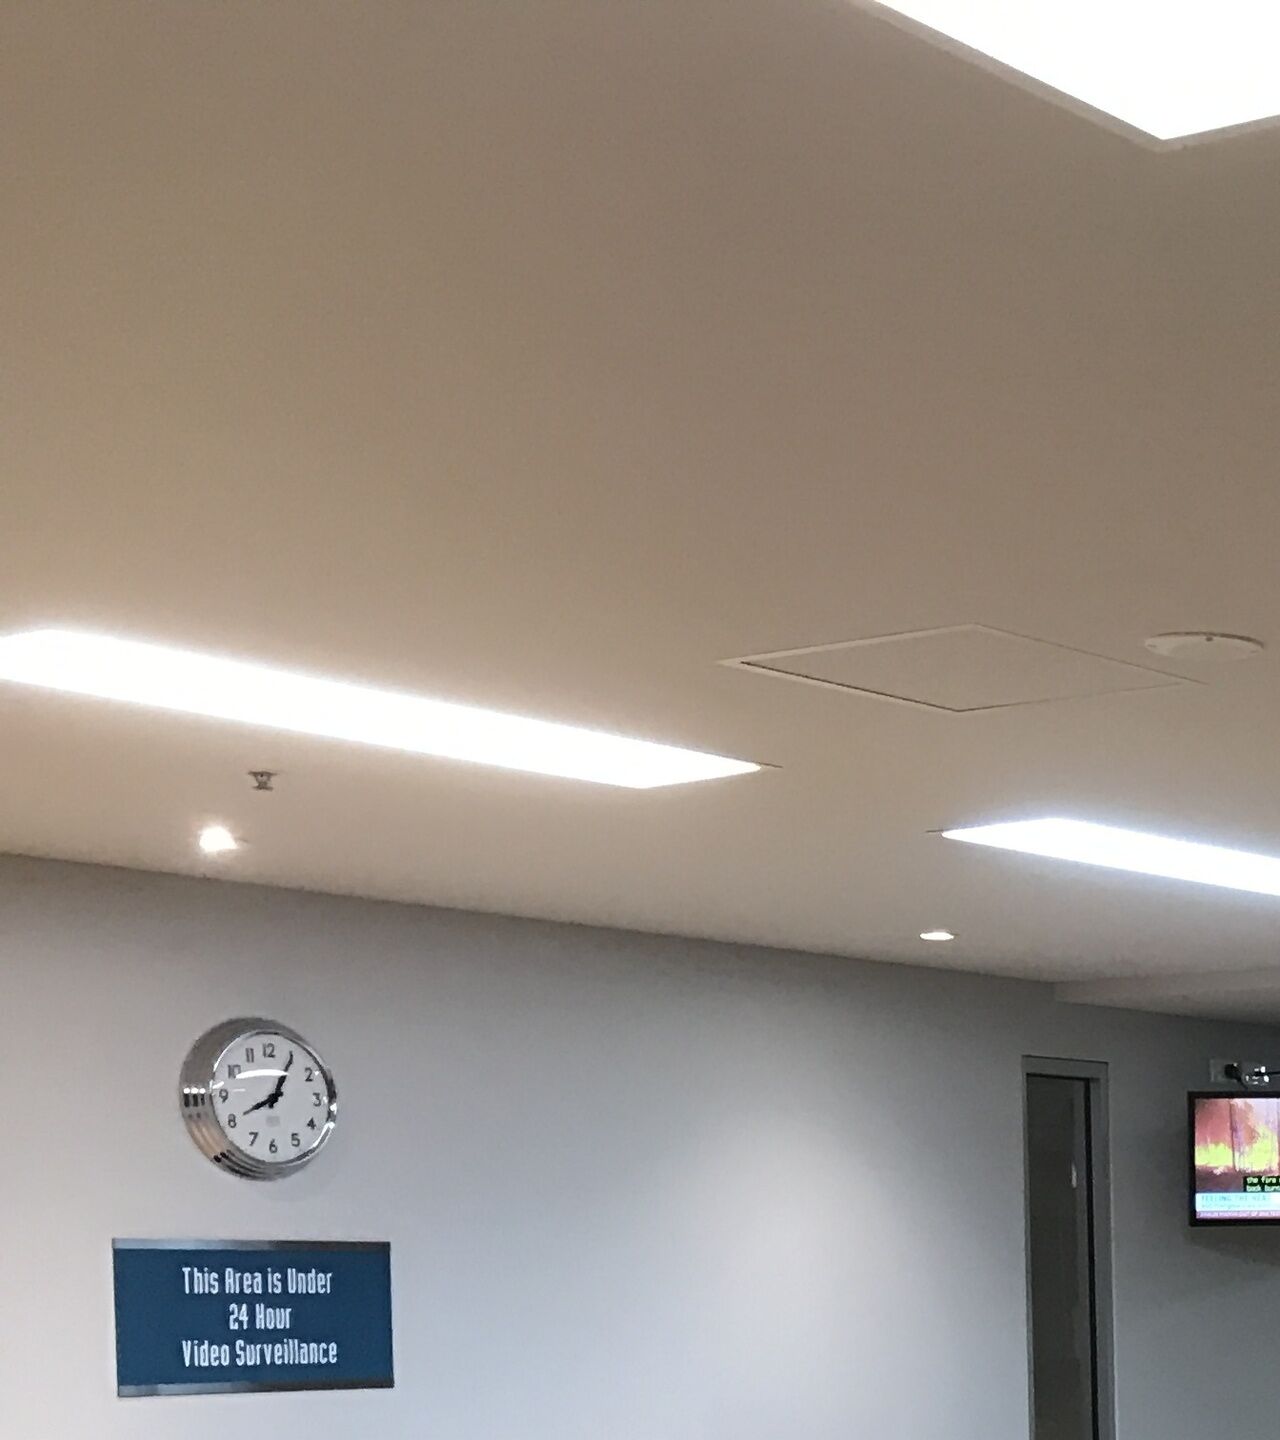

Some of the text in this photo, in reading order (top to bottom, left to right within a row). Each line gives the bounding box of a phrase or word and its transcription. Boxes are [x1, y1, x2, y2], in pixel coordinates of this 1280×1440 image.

[245, 1048, 254, 1063] 11
[262, 1043, 276, 1058] 12
[304, 1067, 314, 1082] 2
[219, 1089, 229, 1104] 9
[312, 1092, 321, 1107] 3
[227, 1113, 237, 1129] 8
[307, 1117, 317, 1131] 4
[249, 1132, 259, 1146] 7
[269, 1139, 278, 1154] 6
[291, 1133, 301, 1147] 5
[182, 1267, 333, 1294] This Area is Under
[229, 1303, 292, 1330] 24 Hour
[182, 1339, 338, 1367] Video Surveillance
